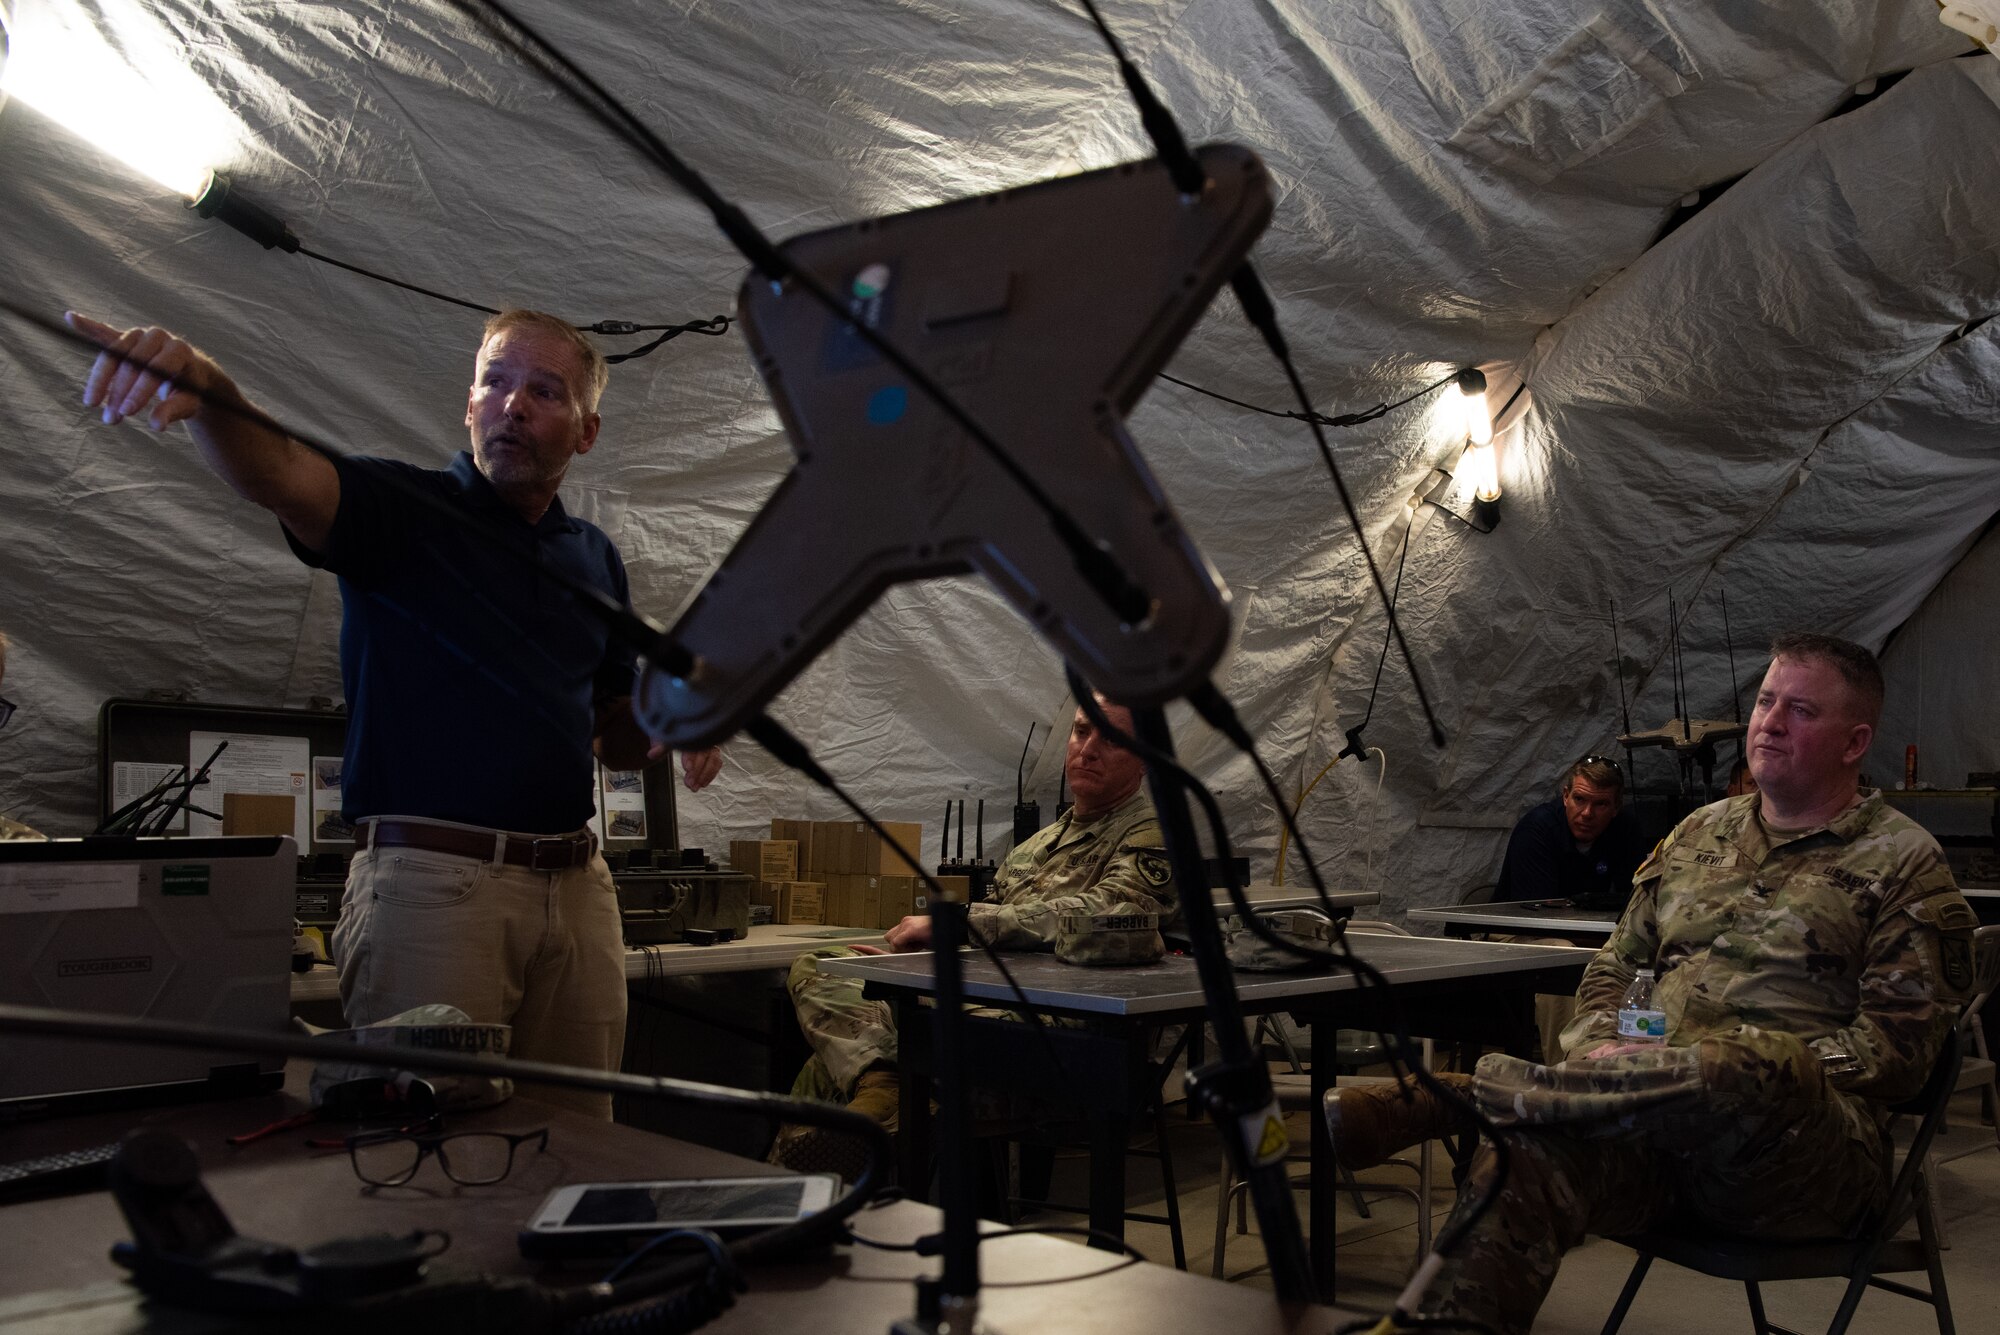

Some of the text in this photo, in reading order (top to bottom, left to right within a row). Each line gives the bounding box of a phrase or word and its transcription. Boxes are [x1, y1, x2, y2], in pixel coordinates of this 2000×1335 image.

[1694, 853, 1726, 866] KIEVIT
[1106, 915, 1149, 929] BARGER
[60, 957, 150, 974] TOUGHBOOK
[410, 1028, 504, 1053] SLABAUGH
